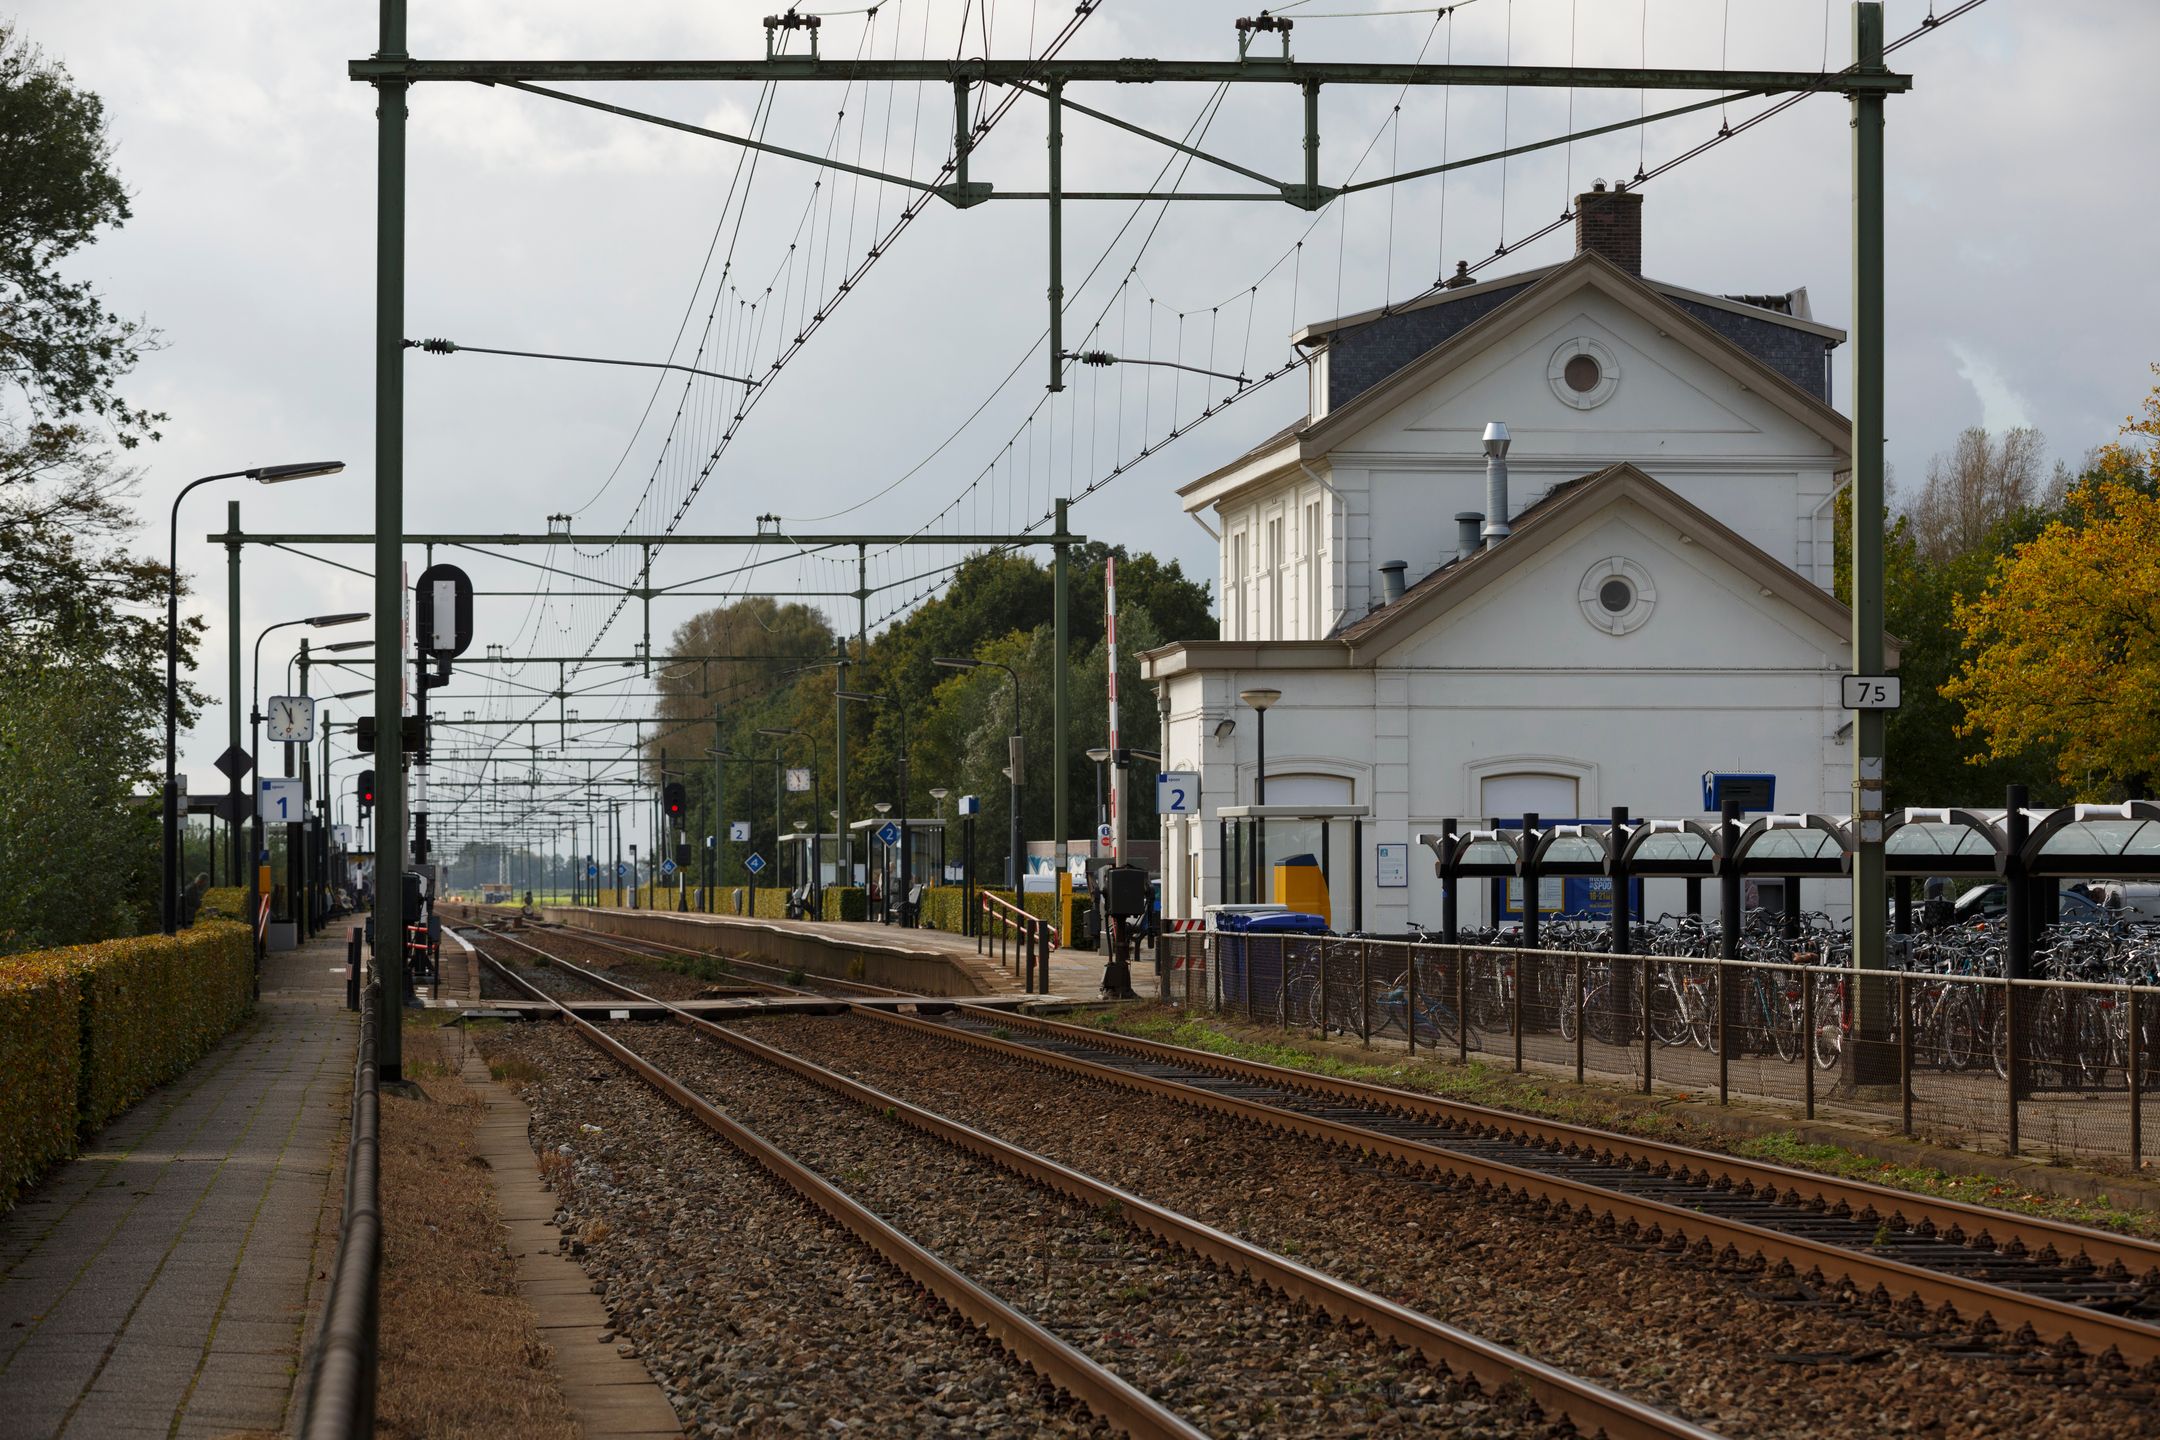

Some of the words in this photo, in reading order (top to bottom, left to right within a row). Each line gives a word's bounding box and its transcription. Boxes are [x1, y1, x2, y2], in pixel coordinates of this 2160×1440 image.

[1858, 682, 1886, 705] 7,5
[1171, 788, 1186, 811] 2
[276, 796, 288, 819] 1
[340, 832, 346, 842] 1
[736, 829, 744, 840] 2
[886, 828, 894, 840] 2
[750, 859, 759, 868] 4
